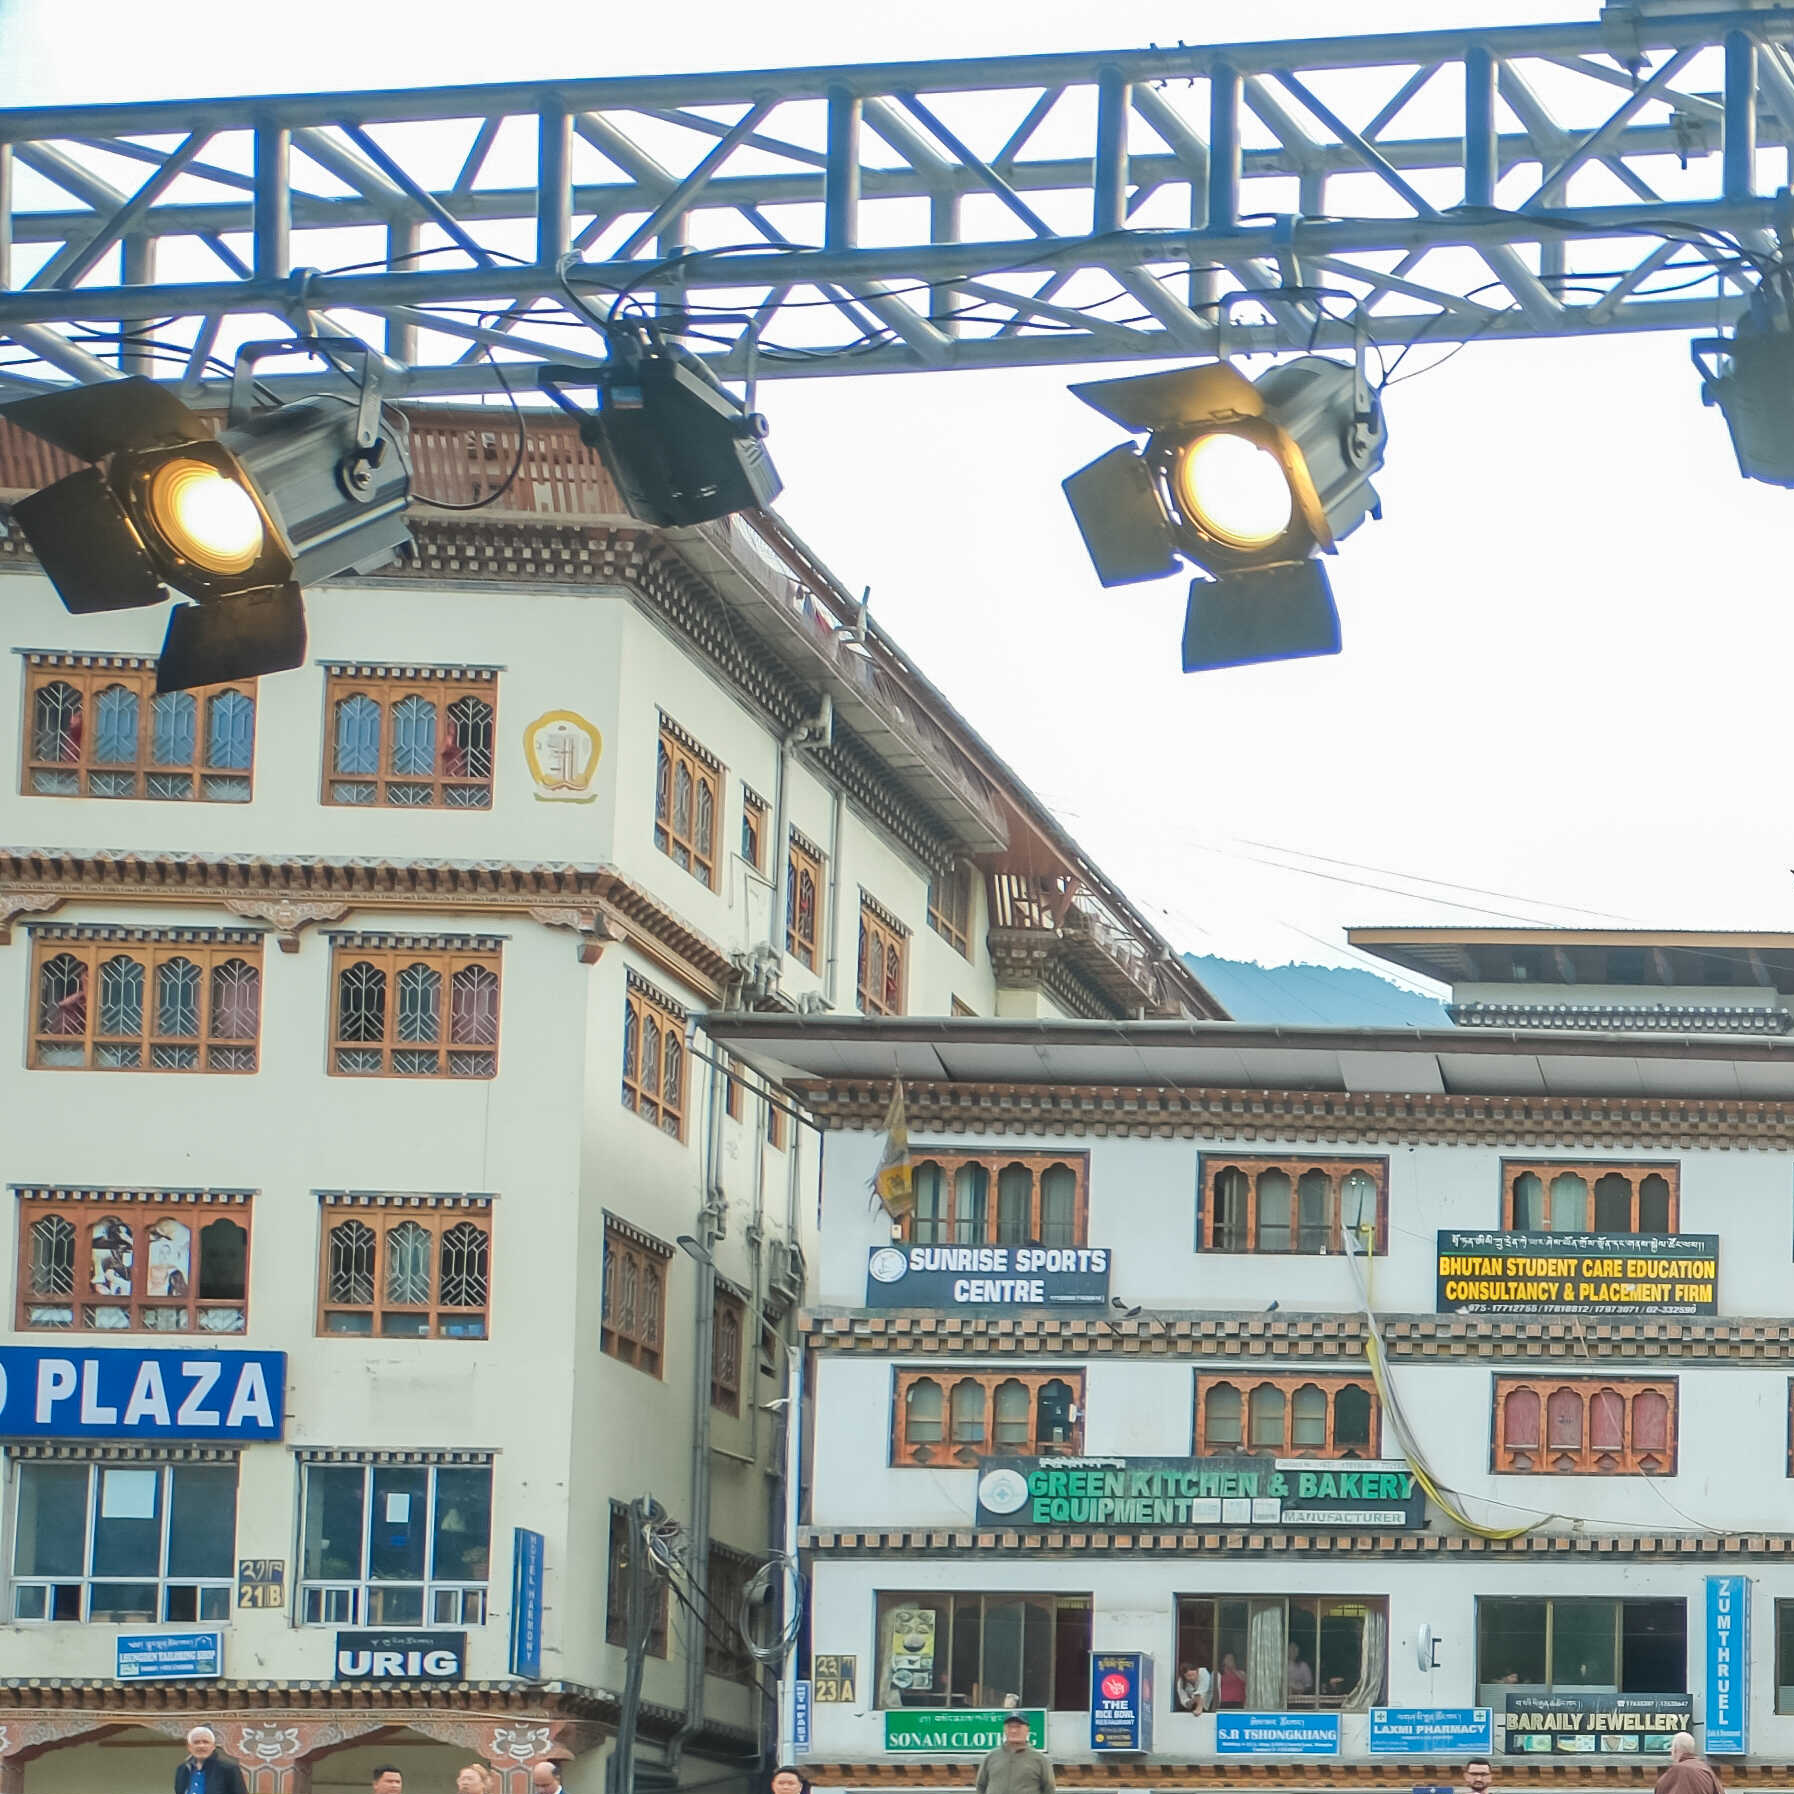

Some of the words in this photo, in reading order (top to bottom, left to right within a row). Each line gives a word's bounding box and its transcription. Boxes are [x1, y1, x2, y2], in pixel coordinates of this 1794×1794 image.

[909, 1248, 1008, 1272] SUNRISE
[1015, 1249, 1107, 1273] SPORTS
[1440, 1256, 1502, 1276] BHUTAN
[1506, 1258, 1578, 1277] STUDENT
[1582, 1259, 1623, 1278] CARE
[1627, 1260, 1716, 1279] EDUCATION
[953, 1280, 1045, 1303] CENTRE
[1445, 1281, 1559, 1301] CONSULTANCY
[1563, 1282, 1575, 1301] &
[1580, 1283, 1672, 1302] PLACEMENT
[1675, 1284, 1713, 1303] FIRM
[35, 1358, 274, 1427] PLAZA
[1028, 1471, 1125, 1497] GREEN
[1130, 1471, 1260, 1497] KITCHEN
[1268, 1472, 1289, 1497] &
[1299, 1472, 1417, 1499] BAKERY
[1032, 1498, 1193, 1523] EQUIPMENT
[1283, 1512, 1402, 1524] MANUFACTURER
[1717, 1579, 1731, 1725] ZUMTHRUEL
[338, 1651, 459, 1677] URIG
[1102, 1700, 1129, 1709] THE
[1374, 1725, 1413, 1734] LAXMI
[1416, 1725, 1487, 1734] PHARMACY
[1506, 1713, 1583, 1731] BARAILY
[1586, 1712, 1690, 1731] JEWELLERY
[889, 1732, 948, 1748] SONAM
[951, 1731, 1038, 1747] CLOTHG
